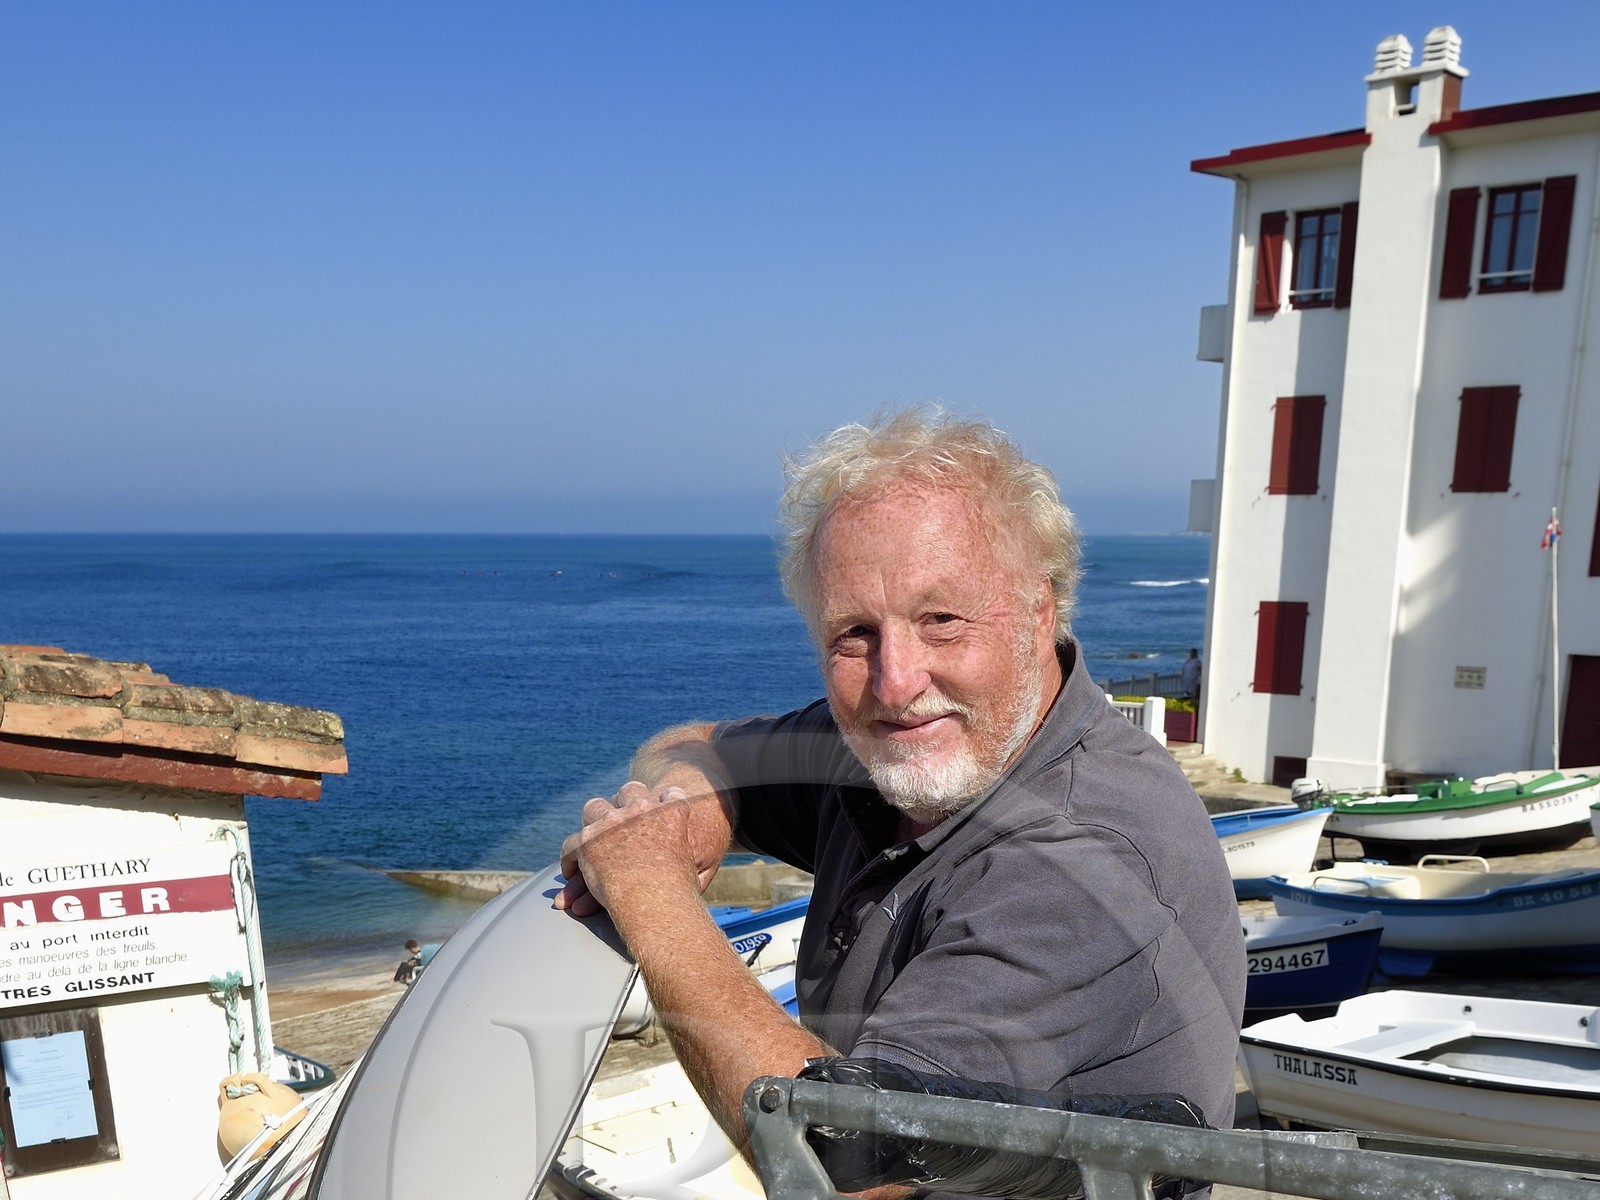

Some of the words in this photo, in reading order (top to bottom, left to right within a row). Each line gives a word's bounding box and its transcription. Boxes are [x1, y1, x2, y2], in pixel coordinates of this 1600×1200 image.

[27, 858, 151, 885] GUETHARY
[2, 887, 171, 928] NGER
[10, 941, 30, 951] au
[42, 934, 78, 949] port
[90, 925, 150, 942] interdit
[18, 949, 89, 966] manoeuvres
[96, 946, 117, 957] des
[123, 940, 158, 954] treuils.
[1248, 949, 1326, 973] 294467
[0, 971, 21, 983] dre
[27, 971, 42, 981] au
[78, 963, 92, 974] de
[98, 961, 108, 972] la
[114, 959, 139, 971] ligne
[145, 952, 190, 966] blanche.
[0, 985, 52, 999] TRES
[65, 971, 155, 993] GLISSANT
[1273, 1053, 1358, 1086] THALASSA
